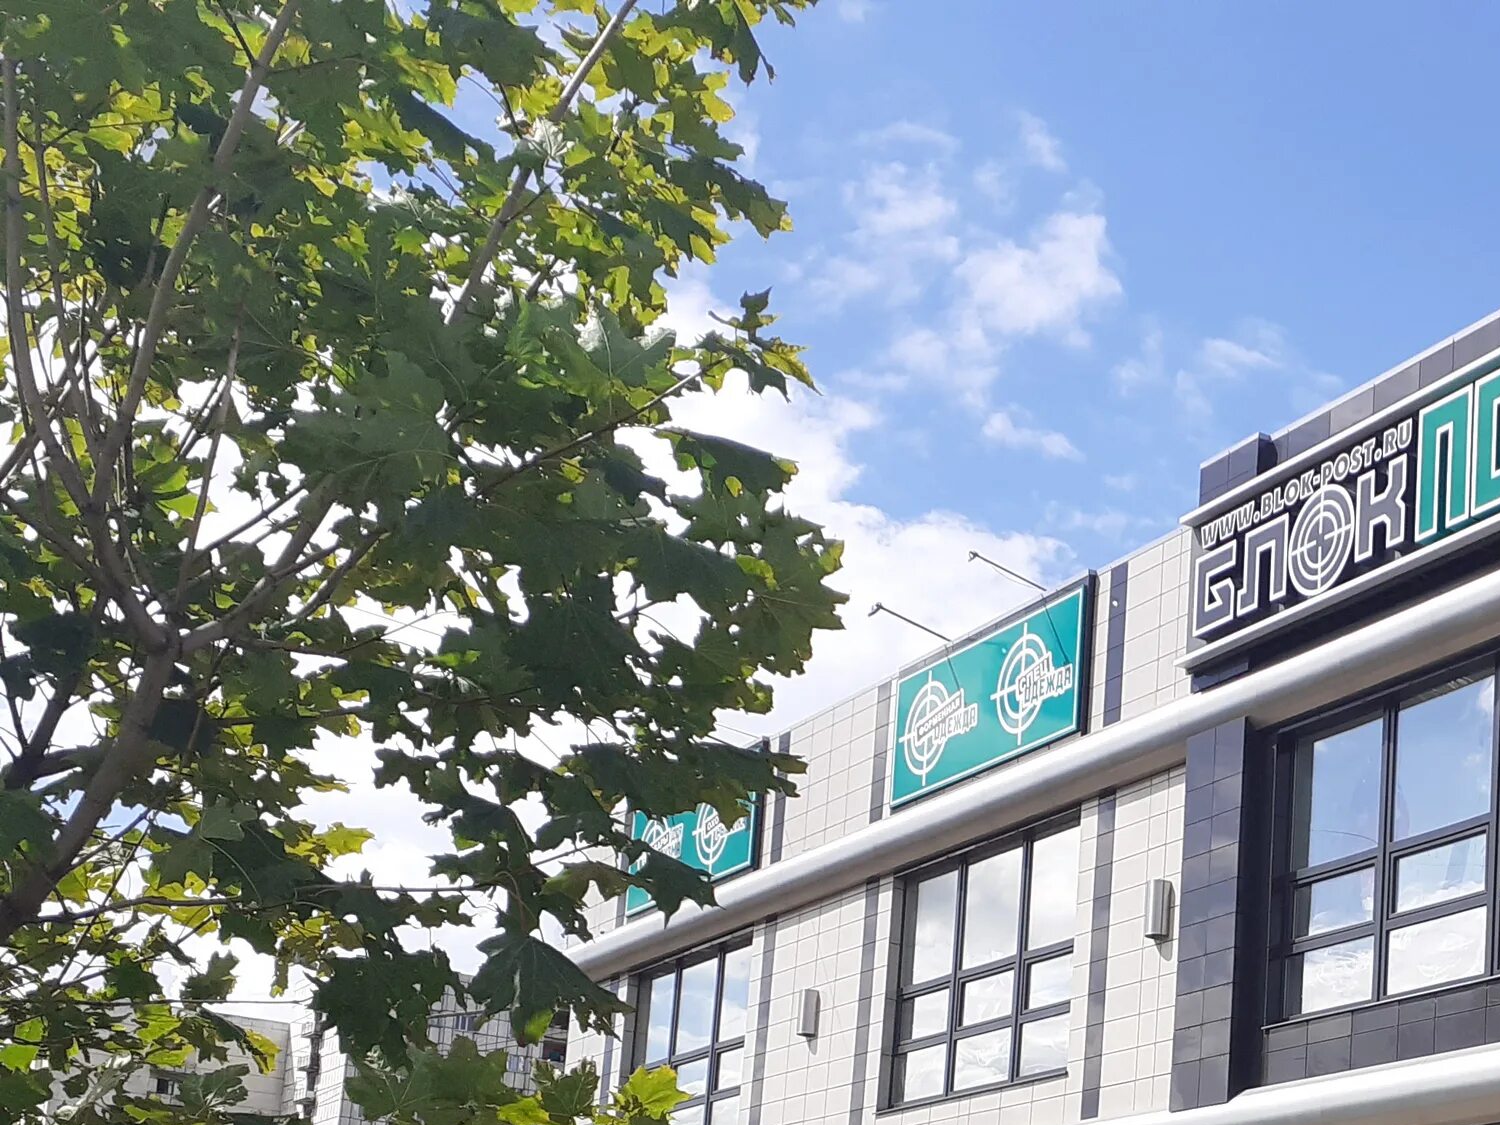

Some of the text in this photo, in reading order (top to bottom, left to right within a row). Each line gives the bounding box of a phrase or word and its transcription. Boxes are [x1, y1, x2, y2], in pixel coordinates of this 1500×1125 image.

[1200, 418, 1413, 550] WWW.BLOK-POST.RU
[1018, 656, 1051, 696] СПЕЦ
[1023, 666, 1072, 710] ОДЕЖДА
